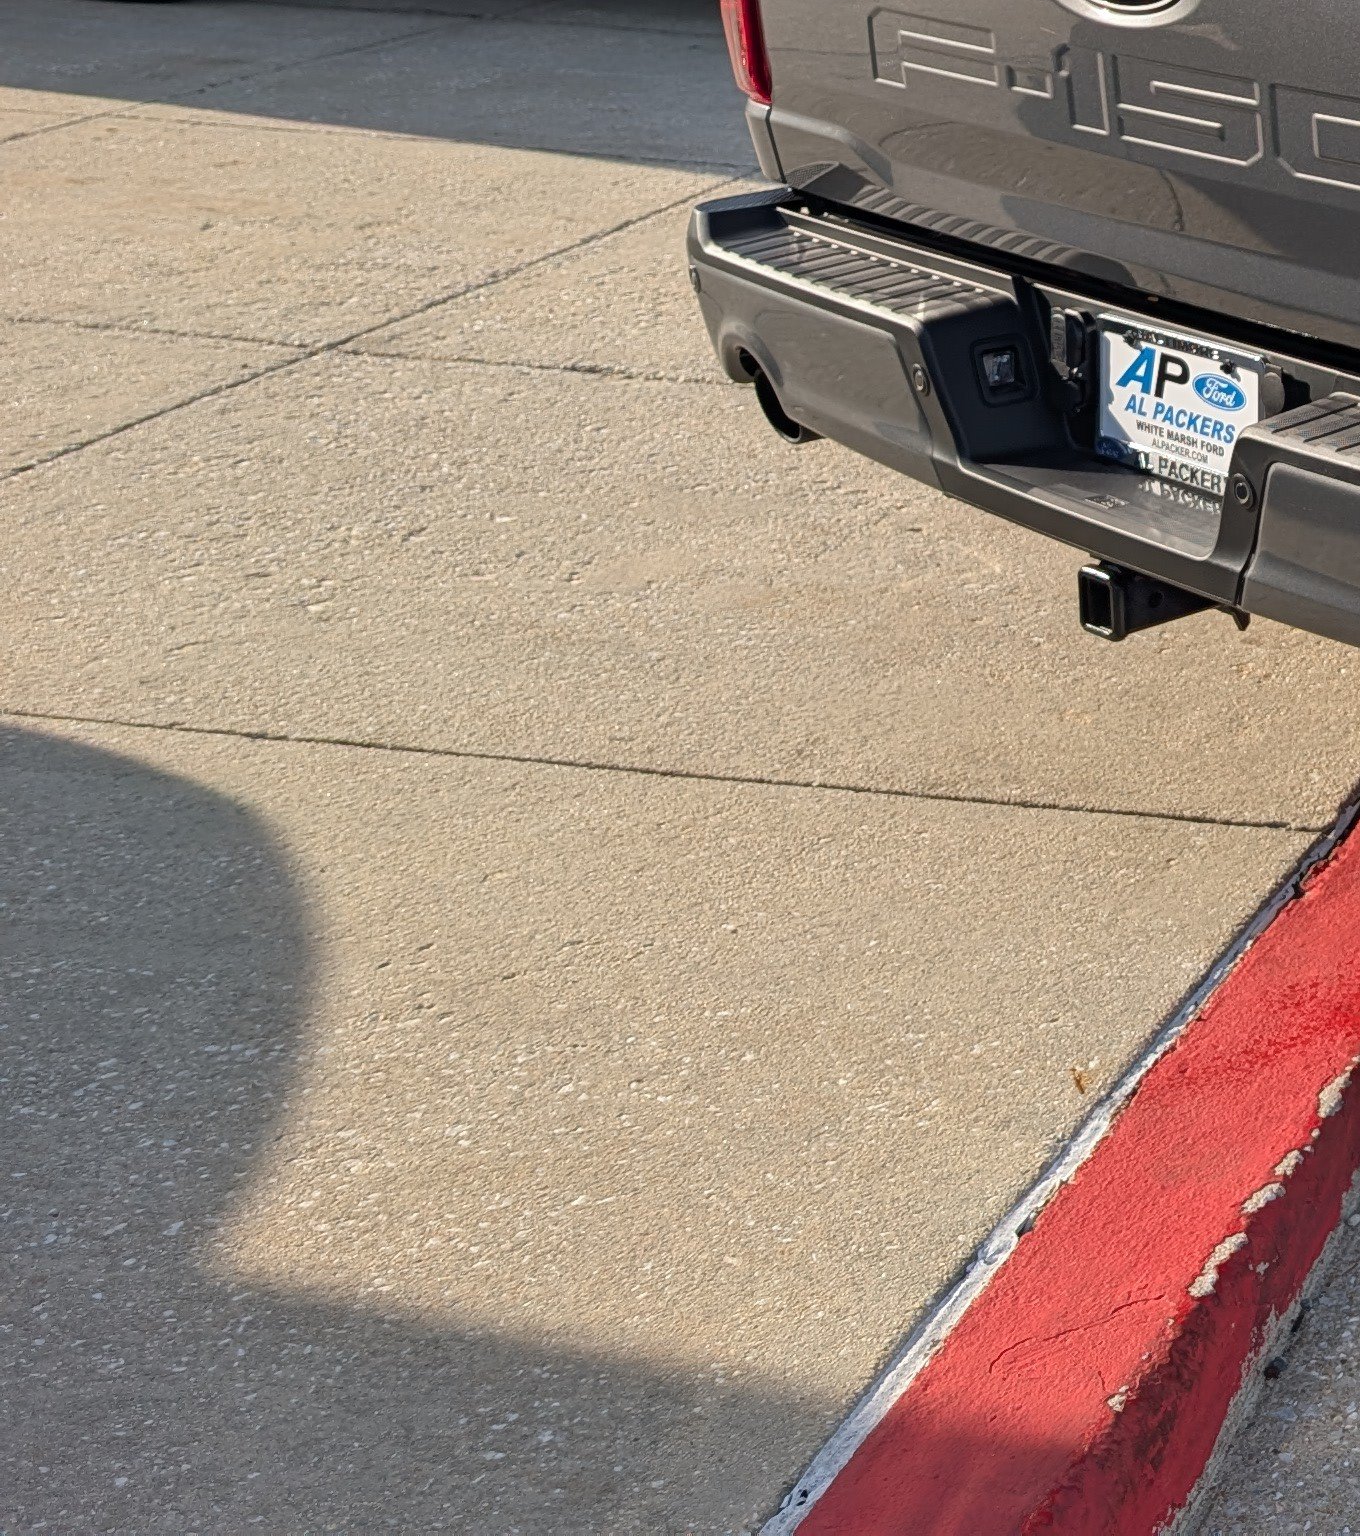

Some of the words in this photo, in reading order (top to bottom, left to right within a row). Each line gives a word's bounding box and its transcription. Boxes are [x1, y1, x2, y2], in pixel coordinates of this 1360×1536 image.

[1115, 345, 1191, 399] AP
[1203, 377, 1237, 408] Ford
[1124, 393, 1148, 417] AL
[1152, 401, 1236, 444] PACKERS
[1136, 419, 1165, 438] WHITE
[1167, 429, 1199, 449] MARSH
[1200, 440, 1225, 457] FORD
[1151, 437, 1209, 464] ALPACKER.COM
[1158, 455, 1229, 494] PACKER
